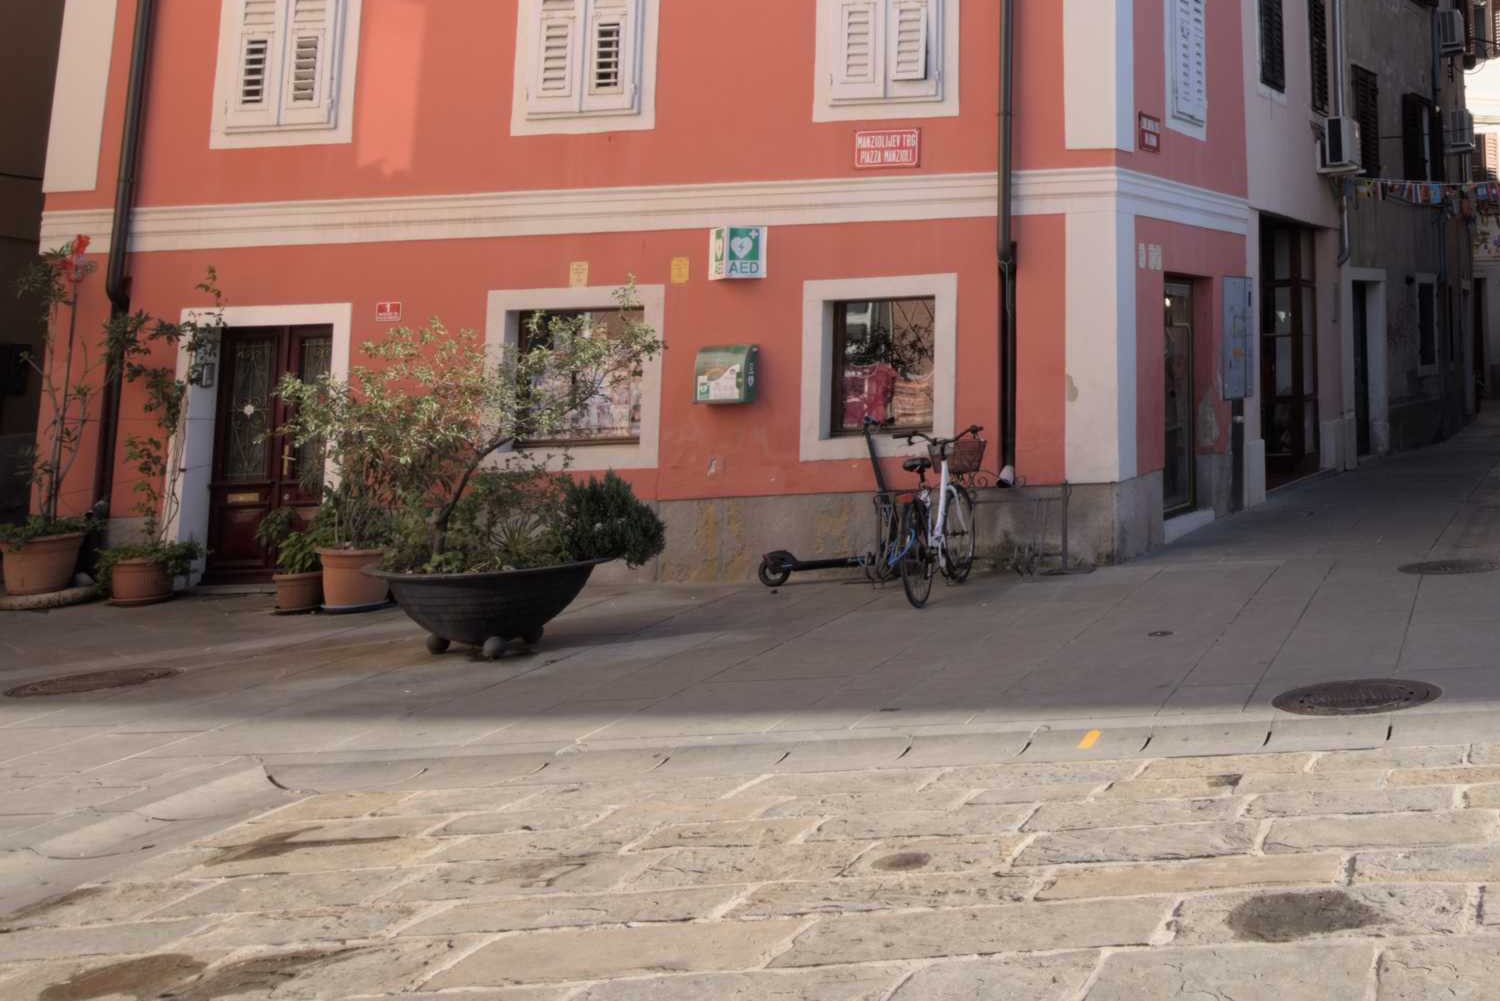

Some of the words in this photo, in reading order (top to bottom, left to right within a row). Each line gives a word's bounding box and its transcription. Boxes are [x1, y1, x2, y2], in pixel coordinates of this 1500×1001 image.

[902, 134, 916, 147] TRG
[860, 150, 881, 163] PIAZZA
[728, 262, 759, 273] AED
